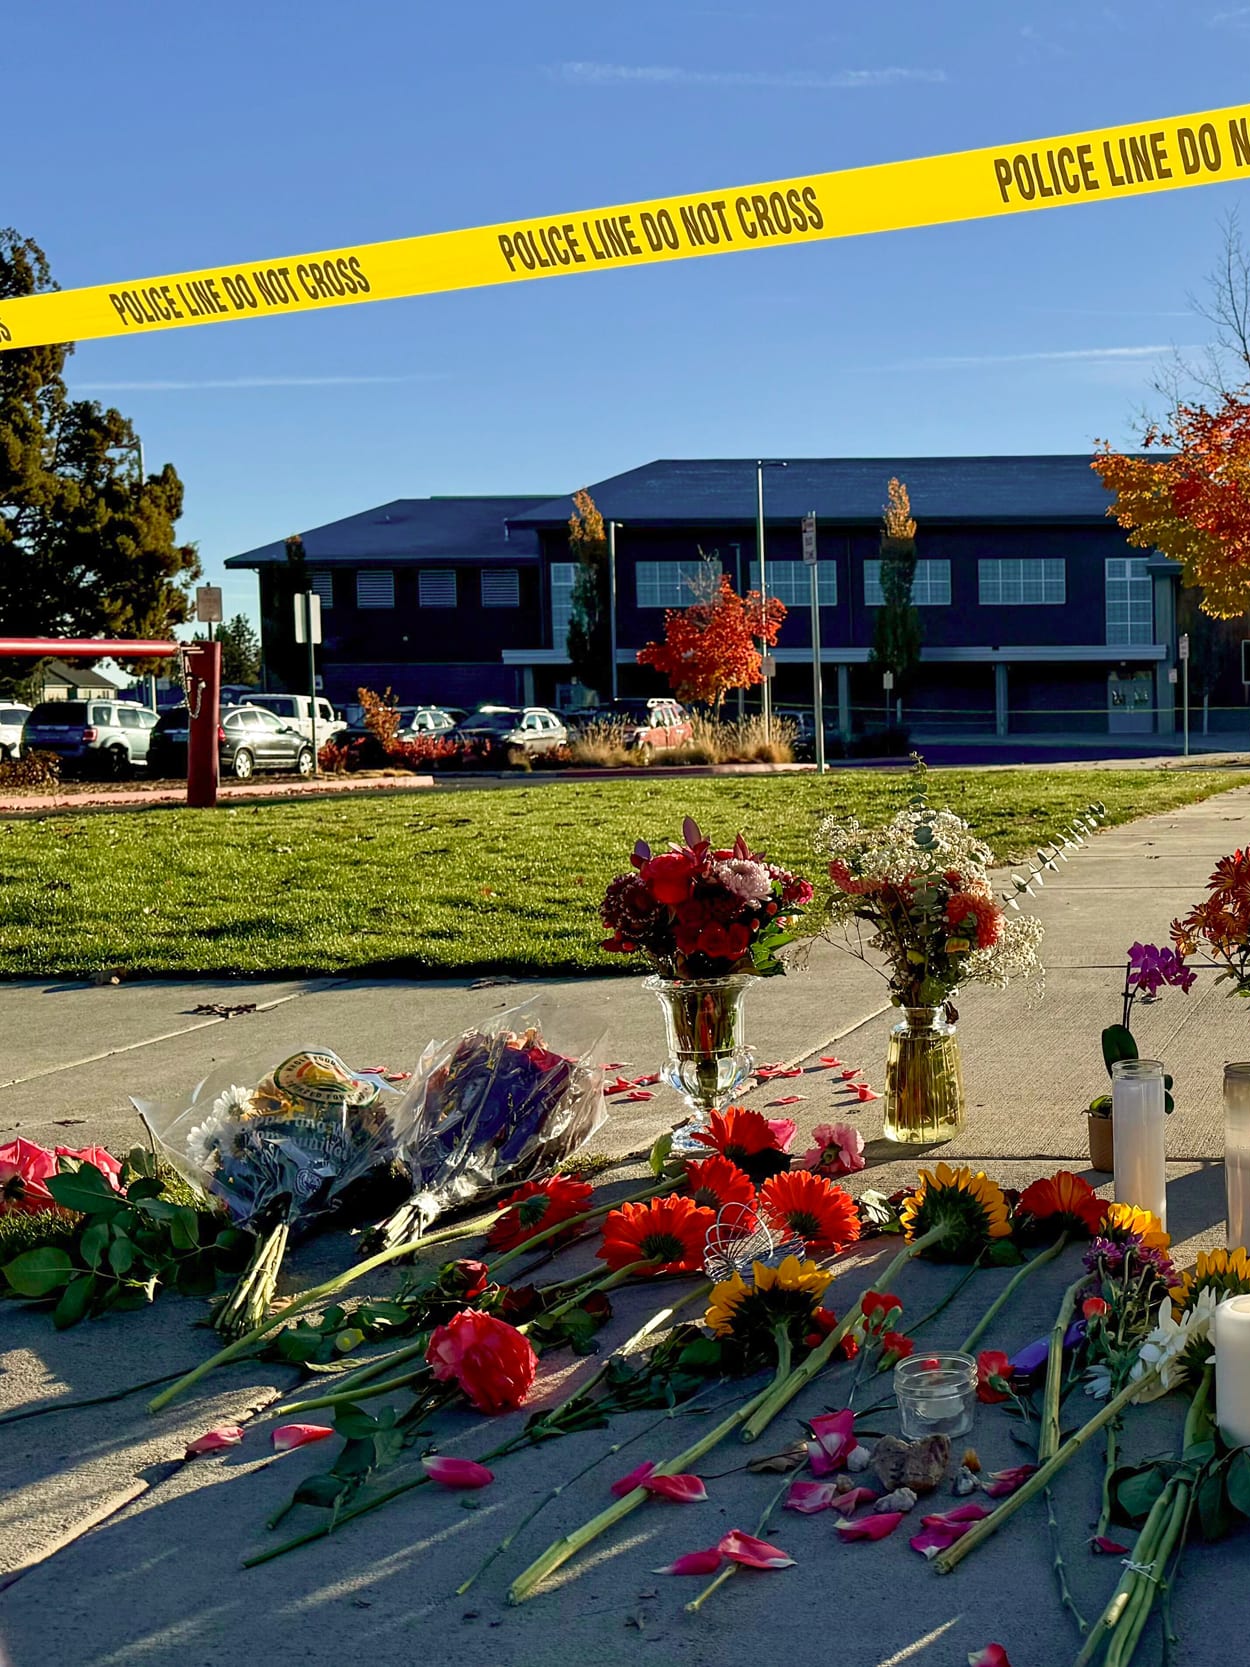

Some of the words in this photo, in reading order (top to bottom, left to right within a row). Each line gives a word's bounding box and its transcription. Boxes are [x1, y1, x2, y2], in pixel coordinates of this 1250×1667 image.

[994, 144, 1099, 203] POLICE
[1103, 132, 1172, 186] LINE
[1177, 123, 1221, 175] DO
[498, 224, 586, 271] POLICE
[583, 215, 642, 262] LINE
[640, 209, 680, 255] DO
[680, 201, 732, 246] NOT
[736, 187, 823, 239] CROSS
[109, 285, 182, 325] POLICE
[177, 279, 229, 318] LINE
[221, 274, 257, 312] DO
[252, 268, 299, 308] NOT
[297, 257, 370, 301] CROSS
